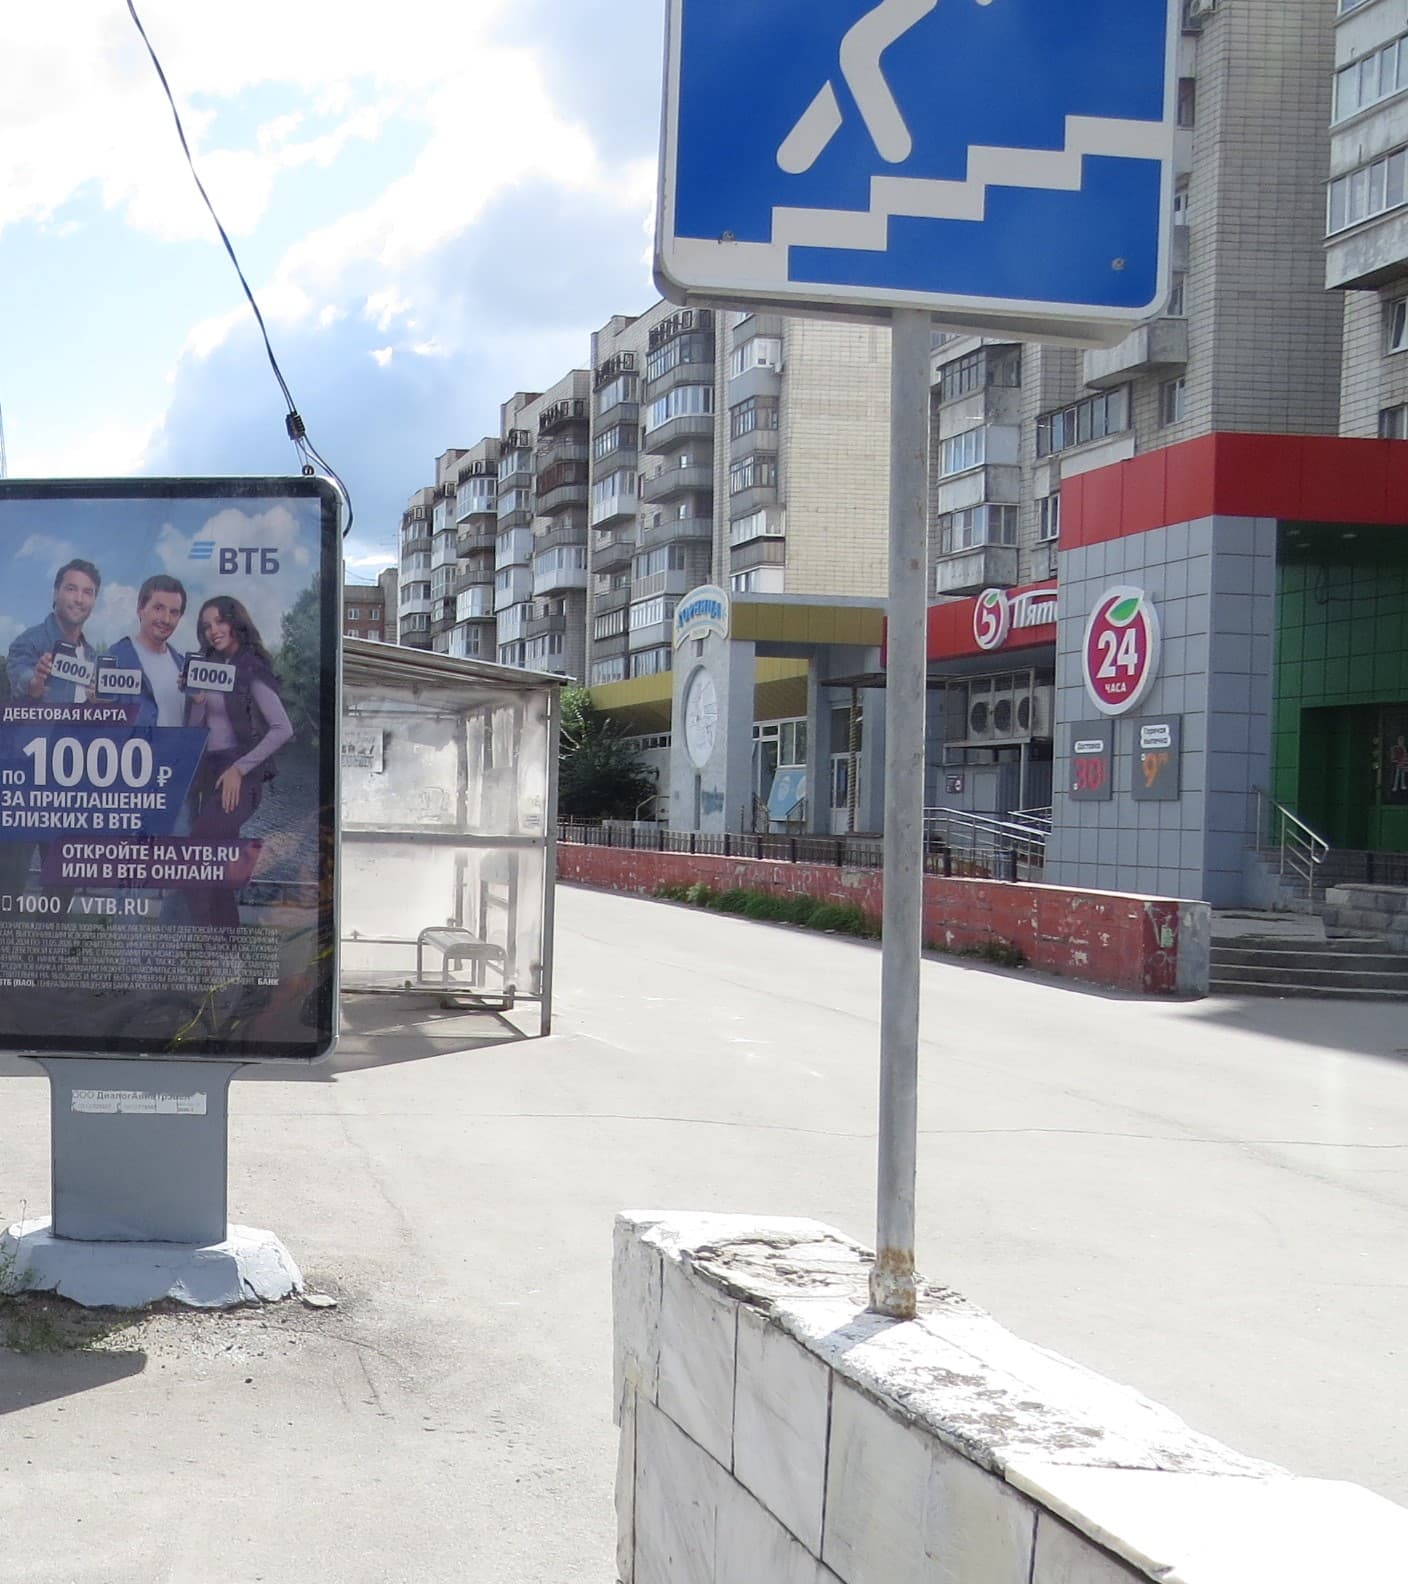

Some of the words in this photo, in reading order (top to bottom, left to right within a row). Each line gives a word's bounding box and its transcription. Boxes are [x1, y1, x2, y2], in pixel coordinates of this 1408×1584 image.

[219, 547, 280, 575] ВТБ
[1010, 590, 1058, 628] Пят
[1096, 628, 1139, 679] 24
[1105, 681, 1127, 693] ЧАСА
[3, 707, 80, 723] ДЕБЕТОВАЯ
[84, 708, 127, 721] КАРТА
[2, 771, 25, 785] ПО
[1, 791, 25, 807] ЗА
[30, 792, 167, 810] ПРИГЛАШЕНИЕ
[2, 812, 88, 829] БЛИЗКИХ
[93, 813, 104, 829] В
[109, 813, 142, 829] ВТБ
[62, 842, 149, 860] ОТКРОЙТЕ
[154, 846, 177, 860] НА
[181, 846, 240, 862] VTB.RU
[62, 863, 98, 878] ИЛИ
[103, 864, 113, 878] В
[117, 864, 147, 879] ВТБ
[151, 862, 224, 880] ОНЛАЙН
[16, 896, 61, 913] 1000
[81, 897, 149, 915] VTB.RU
